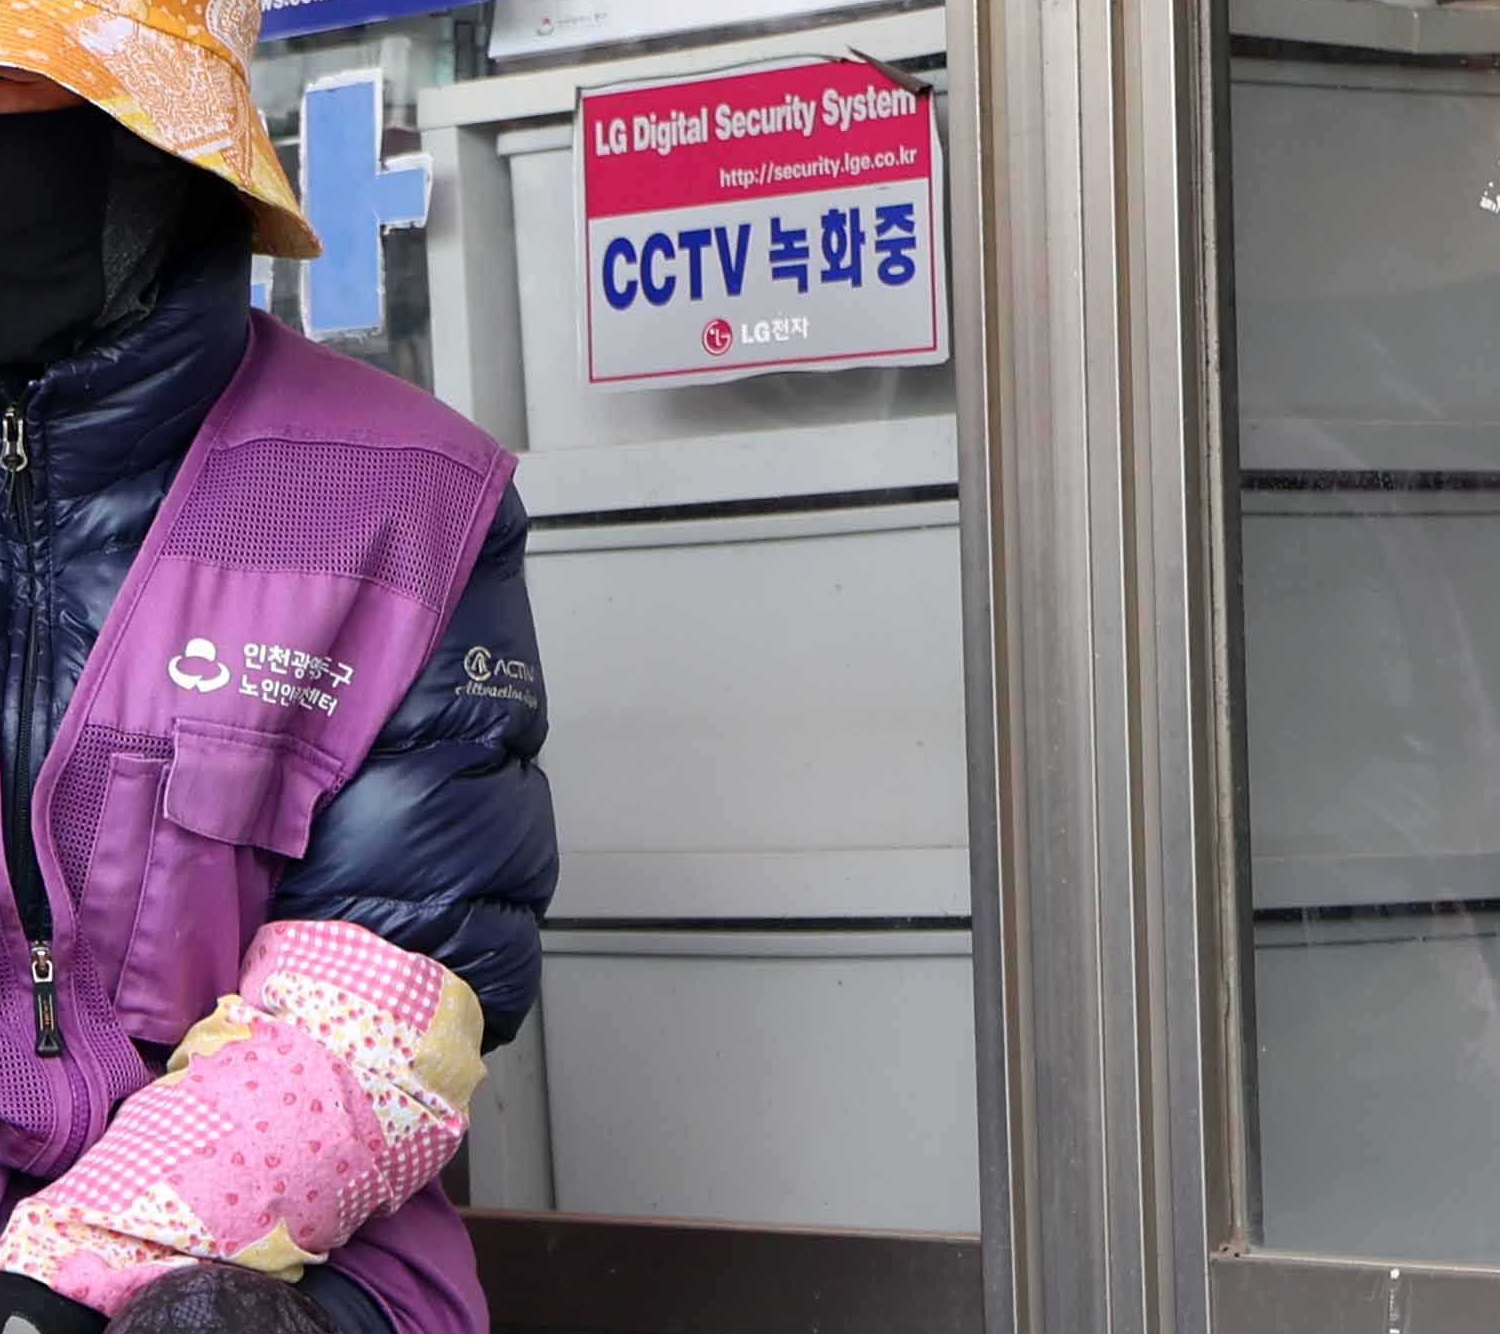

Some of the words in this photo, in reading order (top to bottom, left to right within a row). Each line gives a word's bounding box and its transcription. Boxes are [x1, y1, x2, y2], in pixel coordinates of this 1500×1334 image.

[595, 118, 628, 157] LG
[632, 106, 709, 156] Digital
[714, 93, 816, 141] Security
[821, 84, 917, 131] System
[719, 145, 918, 188] http://security.lge.co.kr
[602, 223, 752, 311] CCTV
[768, 202, 918, 294] 녹화중
[740, 313, 810, 344] LG전자
